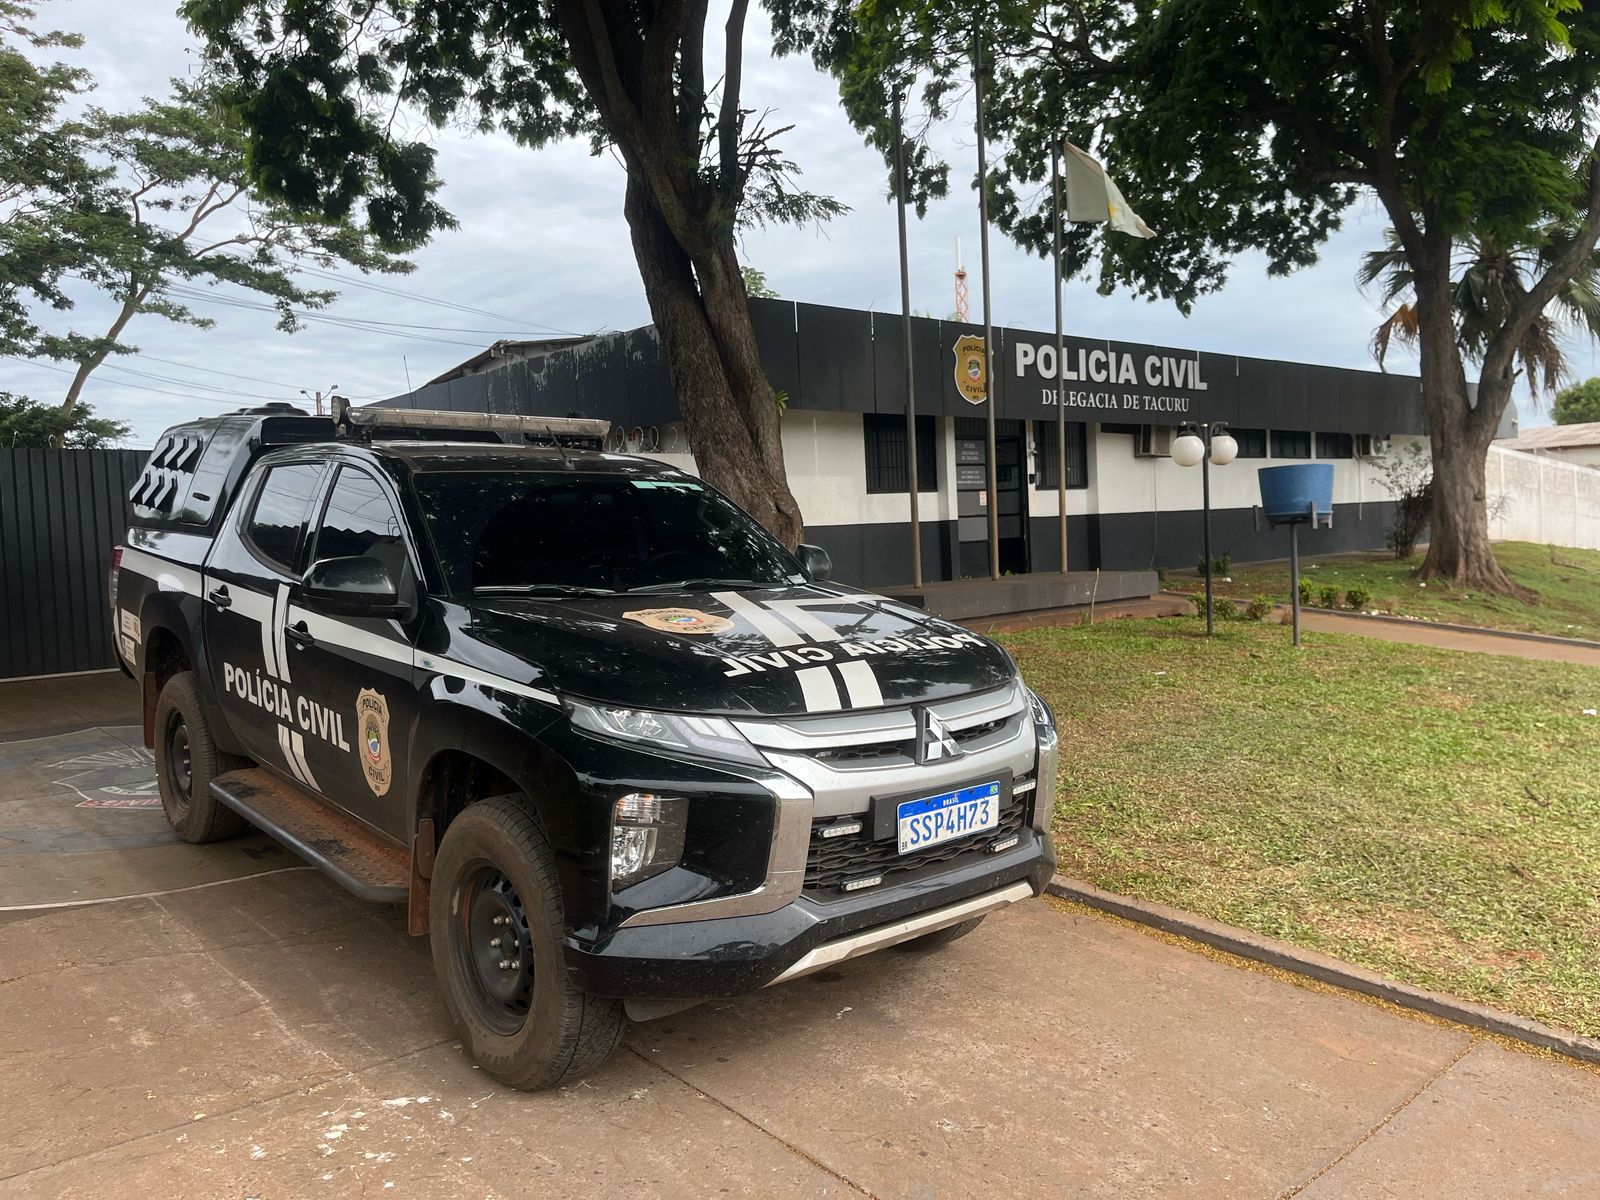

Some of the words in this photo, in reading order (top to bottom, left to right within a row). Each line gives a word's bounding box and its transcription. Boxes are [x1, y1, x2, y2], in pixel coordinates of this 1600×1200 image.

[1015, 342, 1138, 385] POLICIA
[1144, 355, 1208, 390] CIVIL
[1123, 394, 1140, 410] DE
[1143, 396, 1190, 412] TACURU
[224, 662, 294, 723] POLÍCIA
[297, 695, 350, 753] CIVIL
[368, 766, 385, 782] CIVIL
[909, 800, 990, 845] SSP4H73
